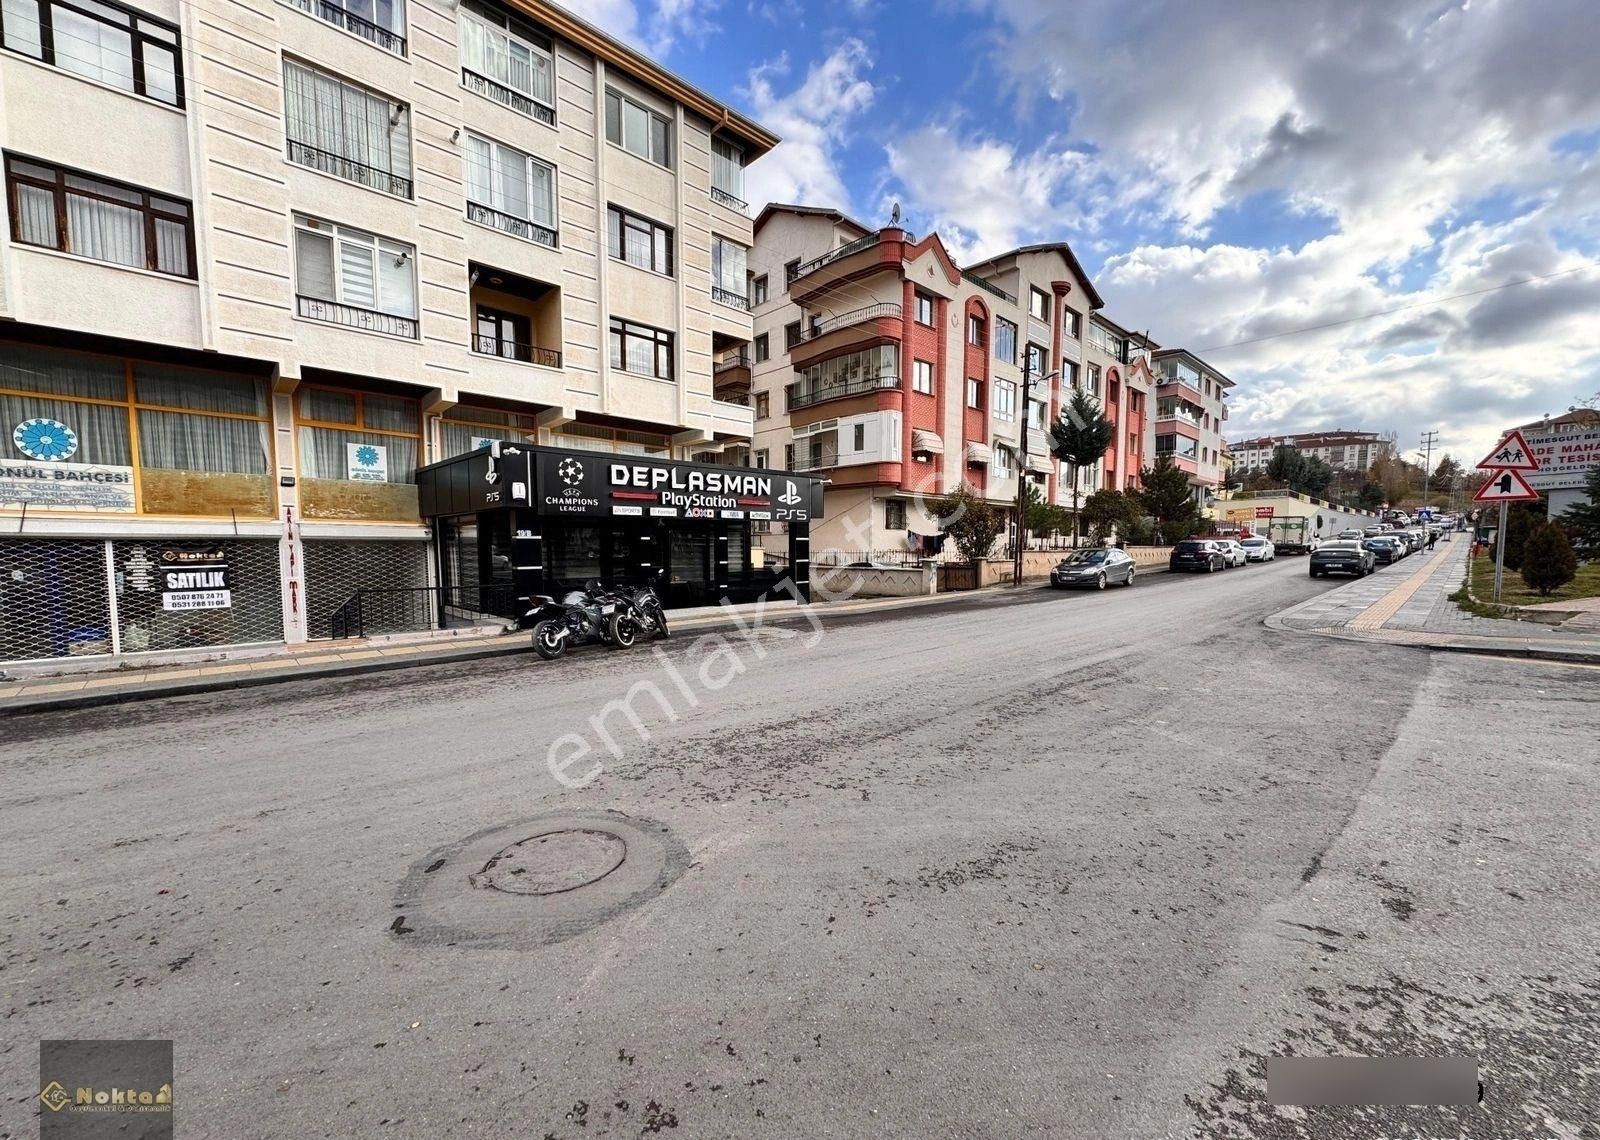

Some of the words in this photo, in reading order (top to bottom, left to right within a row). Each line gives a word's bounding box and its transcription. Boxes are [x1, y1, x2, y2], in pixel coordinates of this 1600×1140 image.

[1525, 435, 1581, 445] TİMESGUT
[54, 470, 129, 484] BAHÇESİ
[610, 464, 771, 496] DEPLASMAN
[486, 492, 500, 502] PS5
[545, 496, 599, 506] CHAMPIONS
[661, 491, 737, 509] PlayStation
[776, 508, 807, 520] PS5
[167, 572, 226, 589] SATILIK
